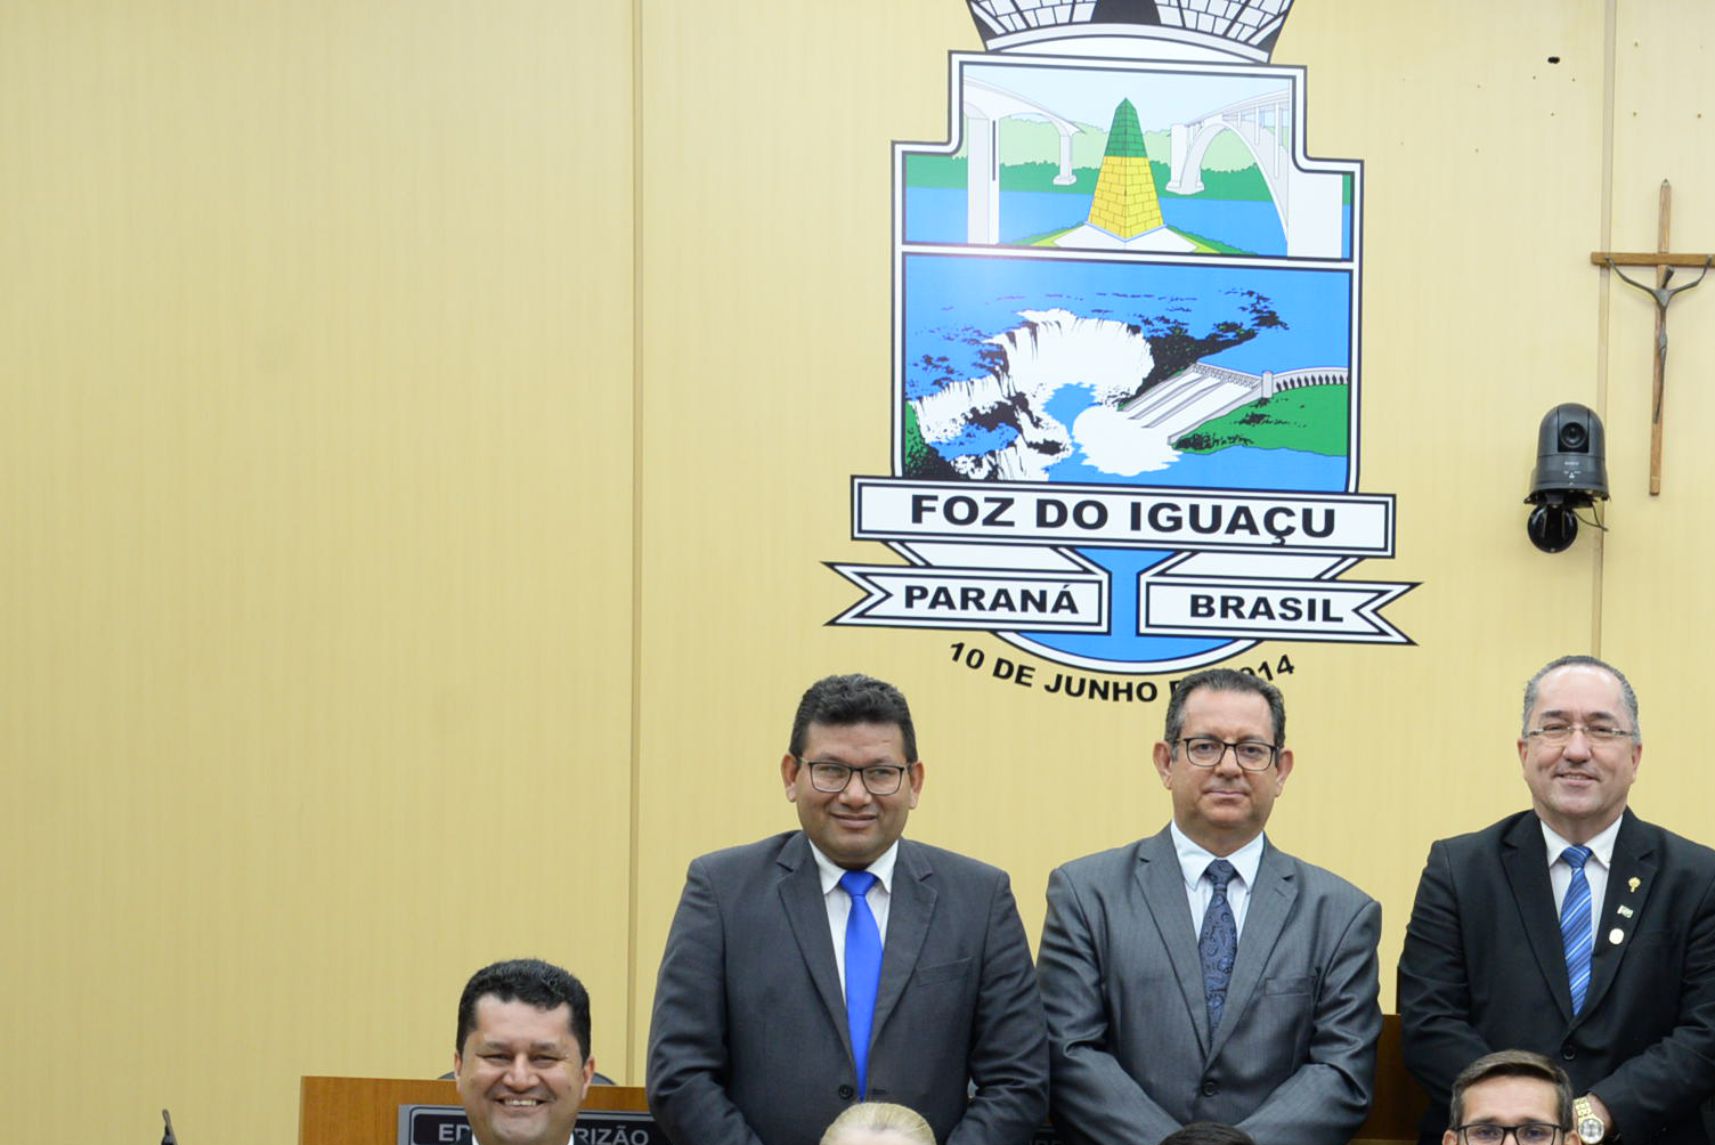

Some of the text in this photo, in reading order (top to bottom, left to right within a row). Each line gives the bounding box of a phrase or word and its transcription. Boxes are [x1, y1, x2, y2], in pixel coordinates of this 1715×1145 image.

[910, 493, 1337, 547] FOZ DO IGUAÇU
[904, 583, 1079, 616] PARANÁ
[1189, 594, 1344, 624] BRASIL
[951, 642, 985, 670] 10
[993, 657, 1035, 687] DE
[1044, 674, 1157, 702] JUNHO
